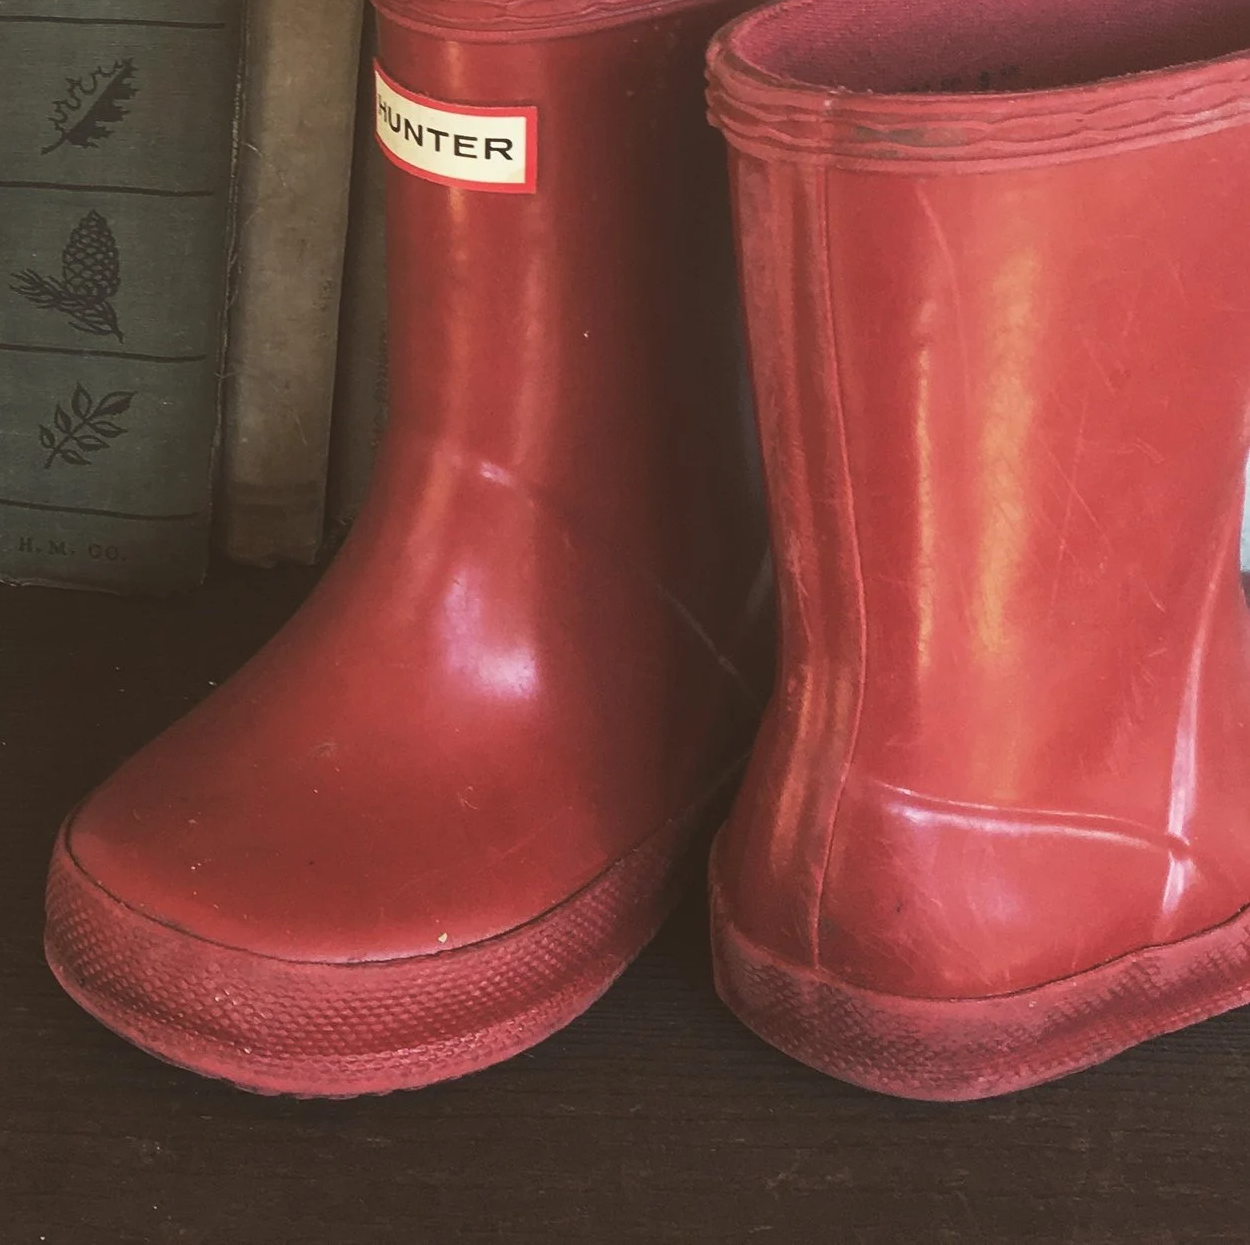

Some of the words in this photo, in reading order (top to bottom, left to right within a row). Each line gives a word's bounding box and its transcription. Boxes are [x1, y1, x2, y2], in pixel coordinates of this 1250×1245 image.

[378, 94, 513, 161] HUNTER
[18, 537, 41, 553] H.
[48, 540, 75, 555] M.
